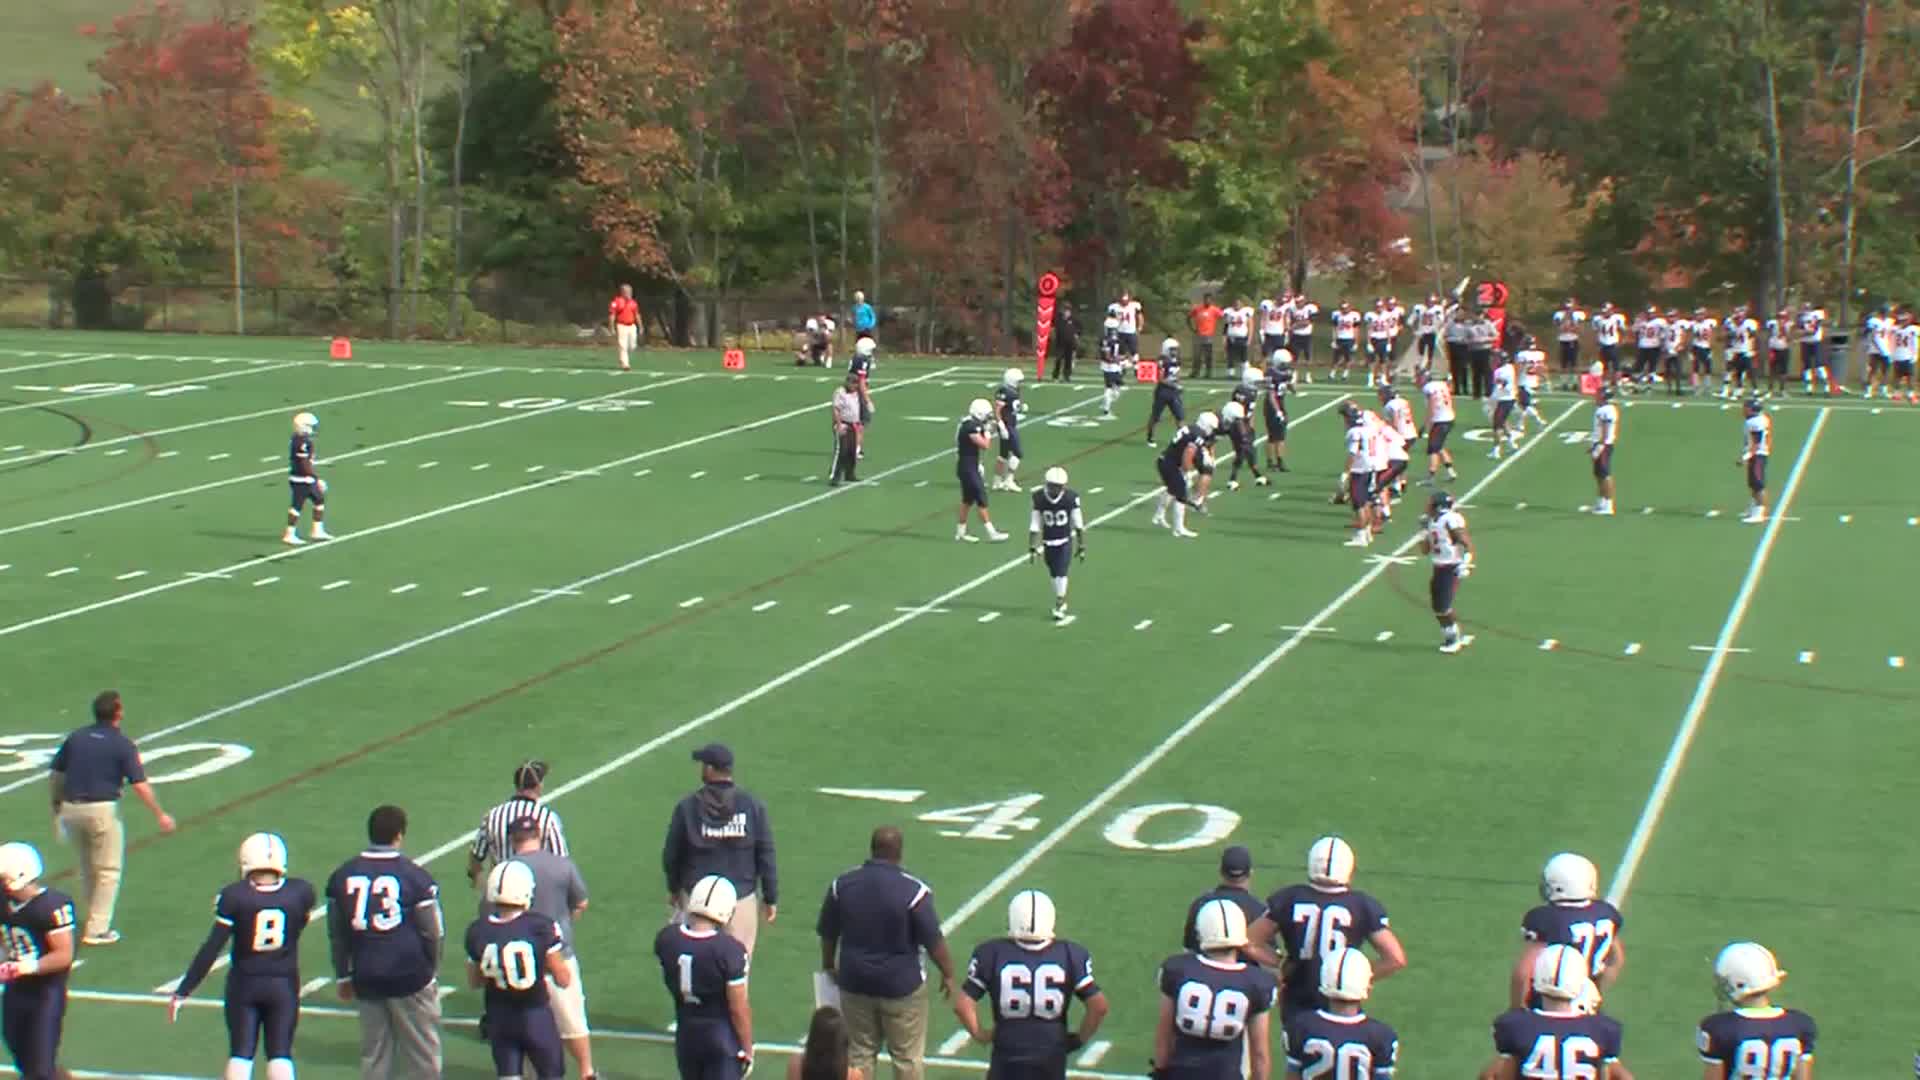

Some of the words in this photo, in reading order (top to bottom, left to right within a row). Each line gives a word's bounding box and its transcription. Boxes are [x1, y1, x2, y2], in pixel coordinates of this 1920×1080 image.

[916, 793, 1242, 851] 40
[252, 909, 286, 952] 8
[346, 875, 403, 932] 73
[1293, 903, 1353, 962] 76
[479, 941, 537, 991] 40
[677, 953, 701, 1005] 1
[1000, 963, 1066, 1019] 66
[1175, 980, 1250, 1041] 88
[1302, 1037, 1372, 1080] 20
[1521, 1034, 1600, 1080] 46
